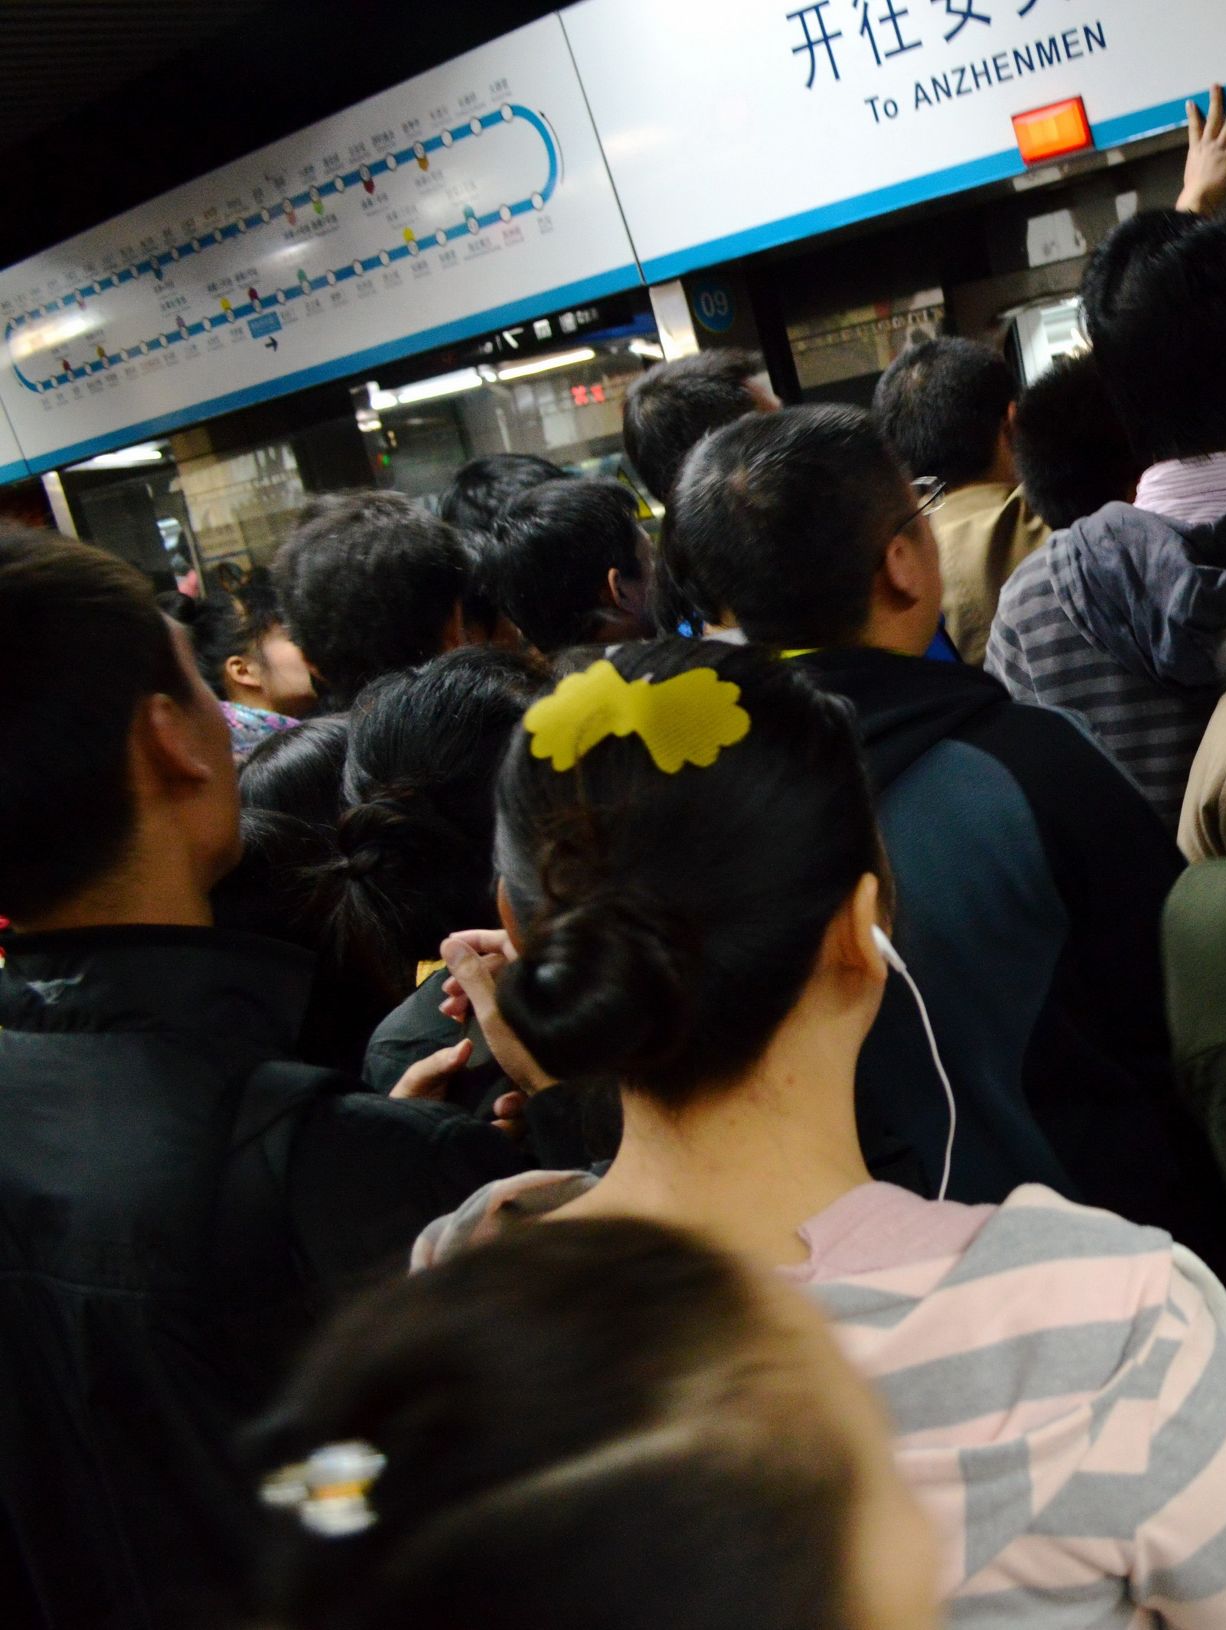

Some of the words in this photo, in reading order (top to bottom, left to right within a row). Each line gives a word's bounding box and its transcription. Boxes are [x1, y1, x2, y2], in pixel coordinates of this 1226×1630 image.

[786, 0, 1068, 89] 开往安
[865, 96, 898, 123] To
[914, 21, 1107, 110] ANZHENMEN
[701, 290, 729, 318] 09
